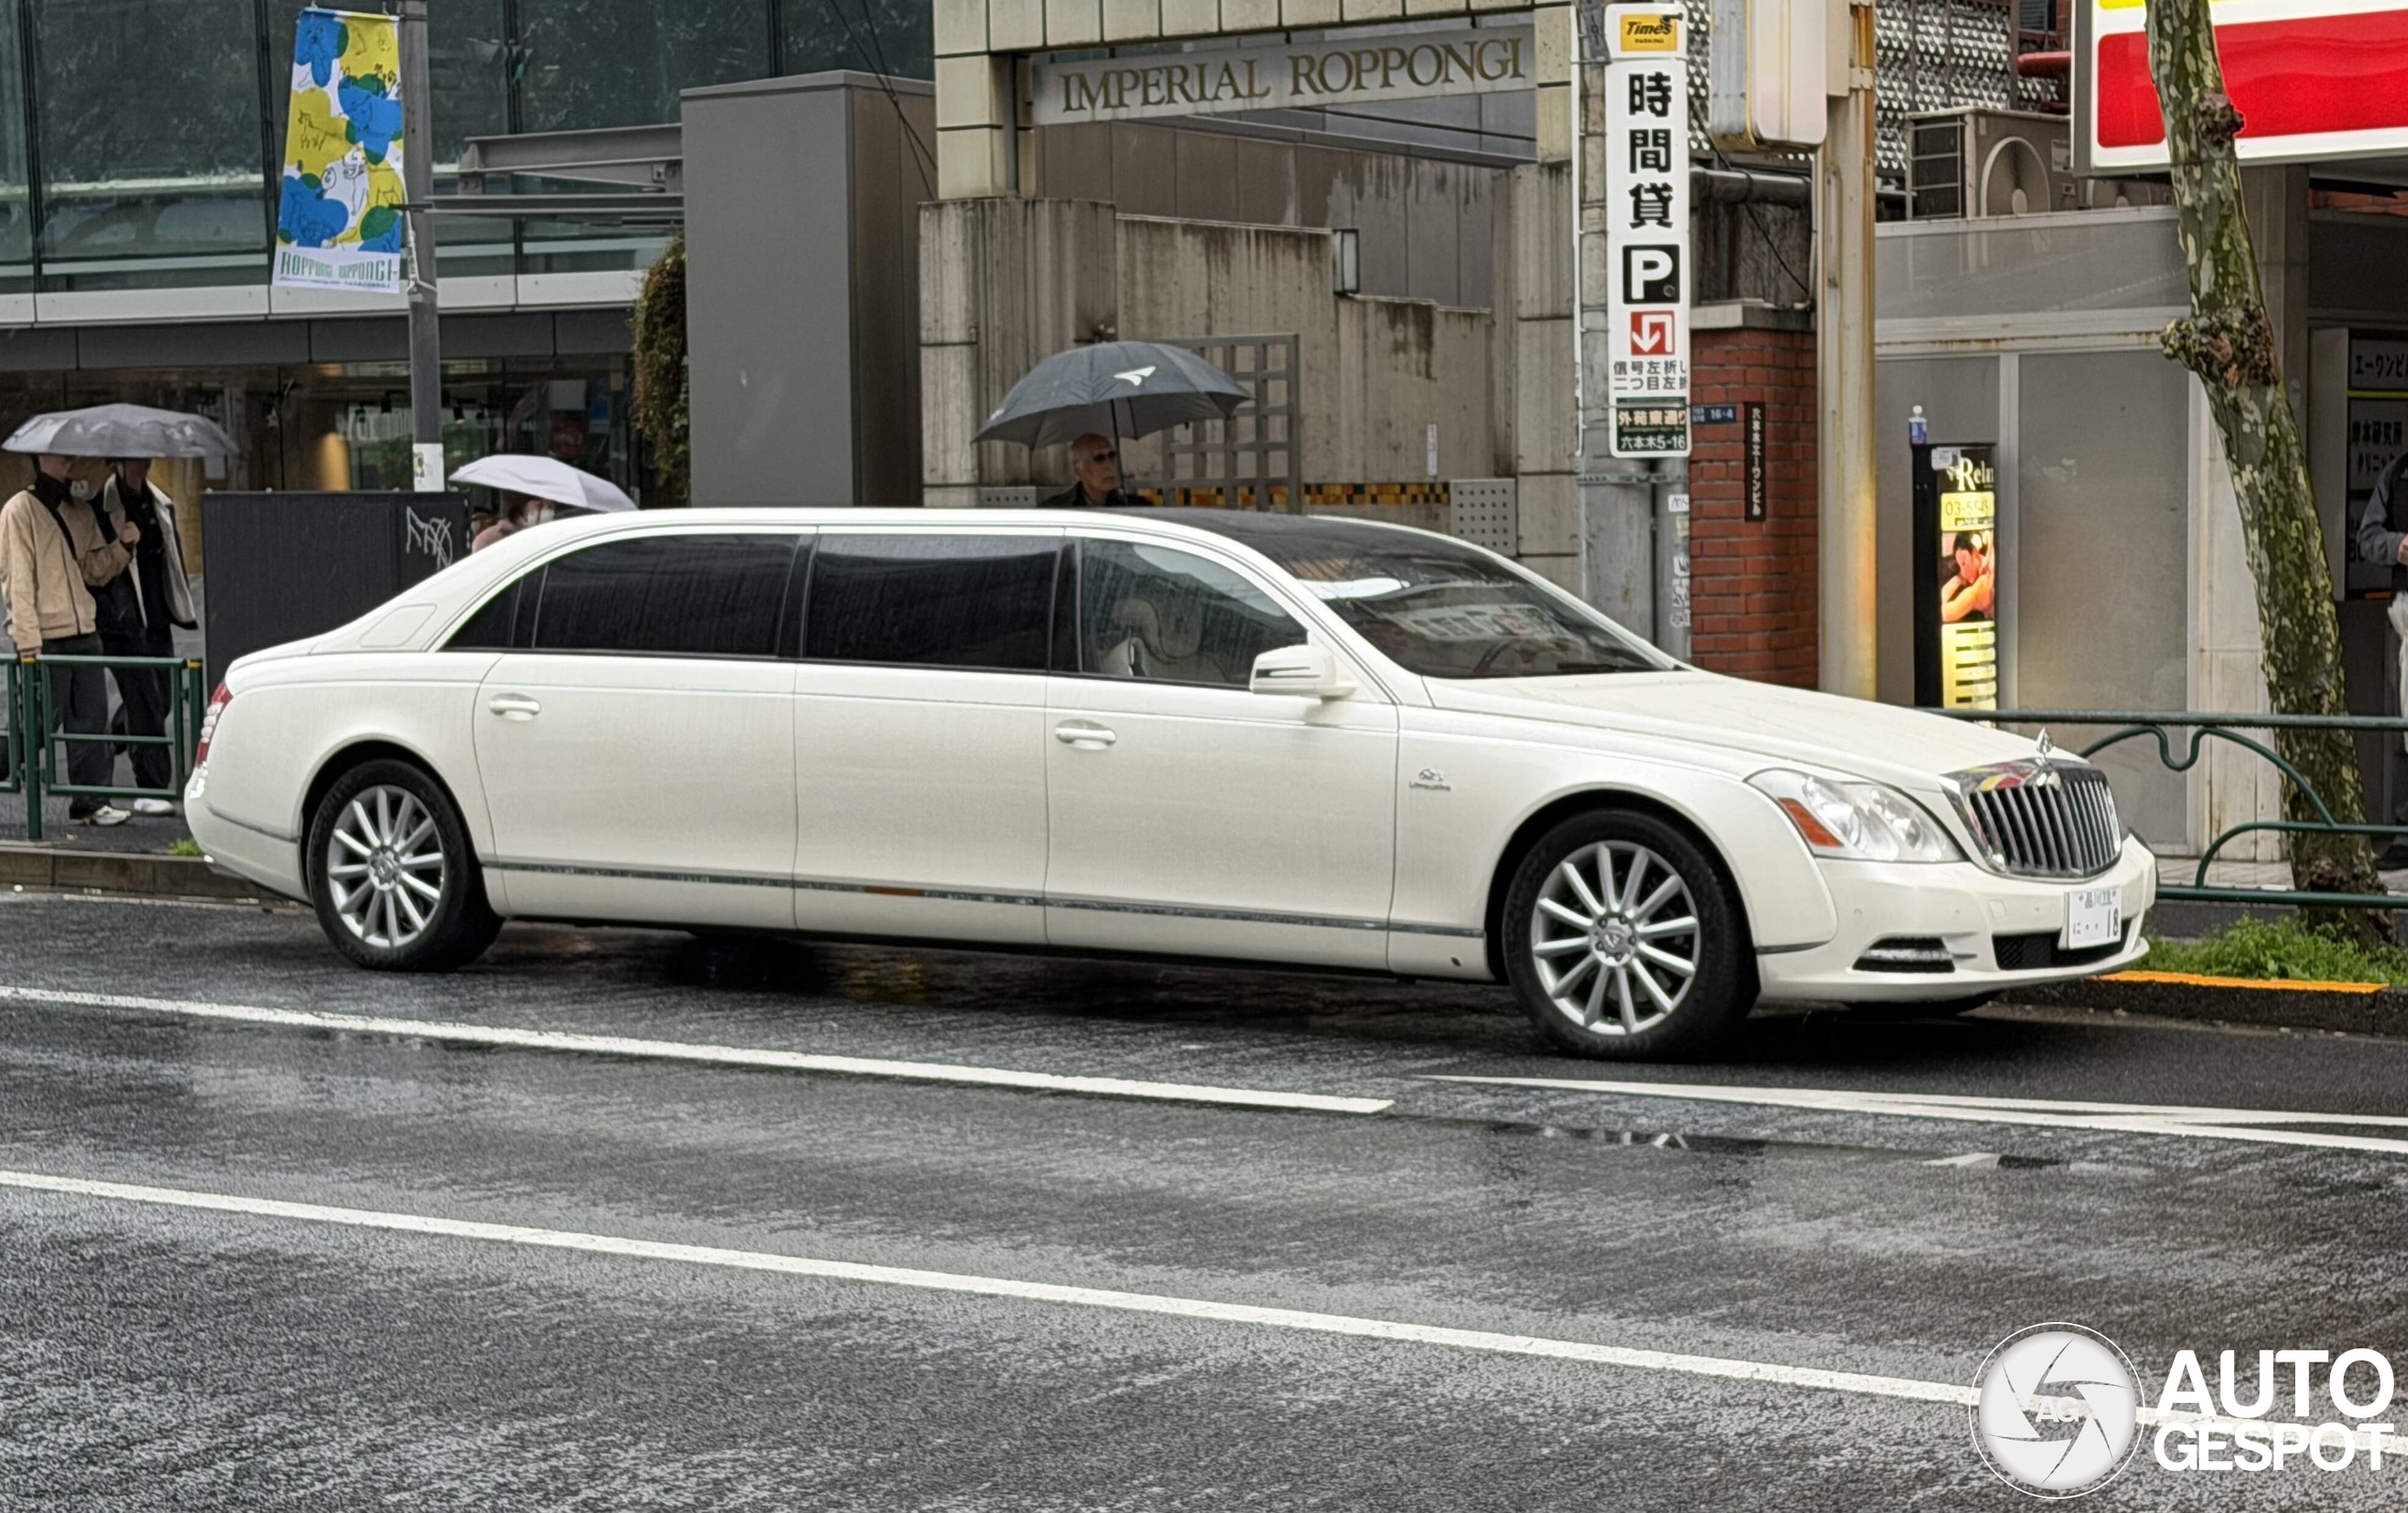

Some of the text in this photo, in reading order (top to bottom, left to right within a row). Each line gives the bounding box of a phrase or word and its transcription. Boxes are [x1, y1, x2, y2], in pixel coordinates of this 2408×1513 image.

[1626, 21, 1672, 36] Times
[1060, 38, 1526, 113] IMPERIAL ROPPONGI
[1628, 71, 1673, 229] 時間貸
[1630, 249, 1673, 300] P
[2354, 354, 2408, 378] エーワンビ
